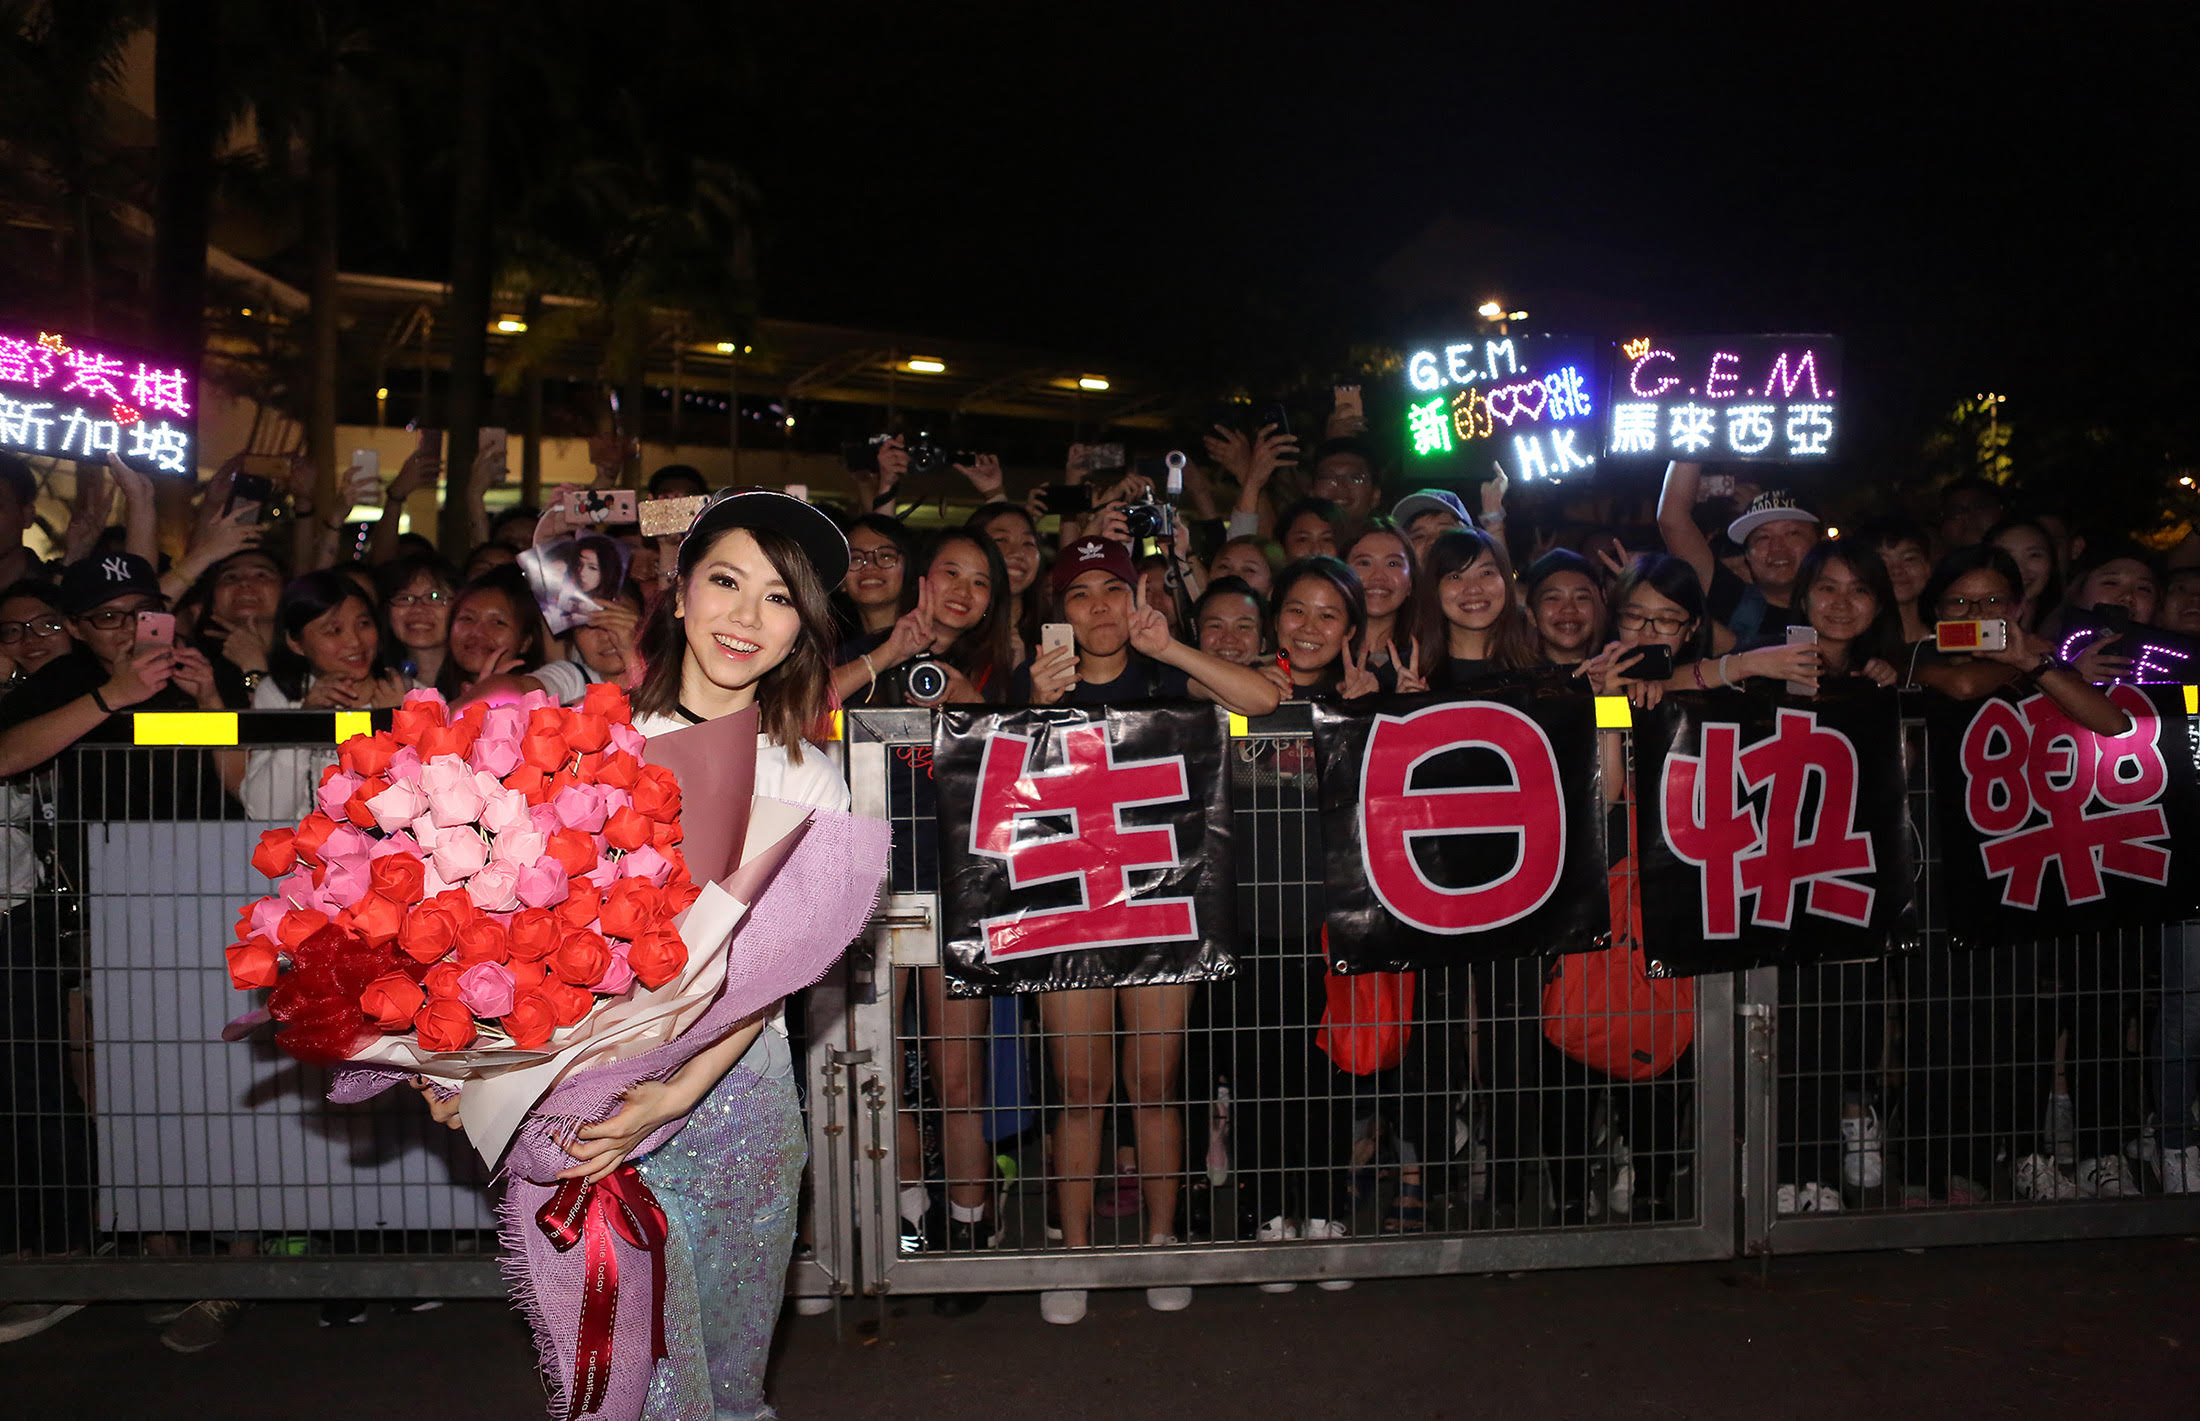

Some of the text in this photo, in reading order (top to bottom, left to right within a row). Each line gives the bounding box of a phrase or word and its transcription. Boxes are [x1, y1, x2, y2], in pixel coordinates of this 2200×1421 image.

[1409, 338, 1528, 391] G.E.M.
[1629, 349, 1835, 400] G.E.M.
[0, 392, 188, 473] 新加坡
[1513, 428, 1595, 481] H.K.
[1611, 402, 1834, 455] 馬來西亞
[101, 556, 132, 581] NY
[550, 1175, 591, 1239] arEastFlora.com
[595, 1261, 607, 1293] Today
